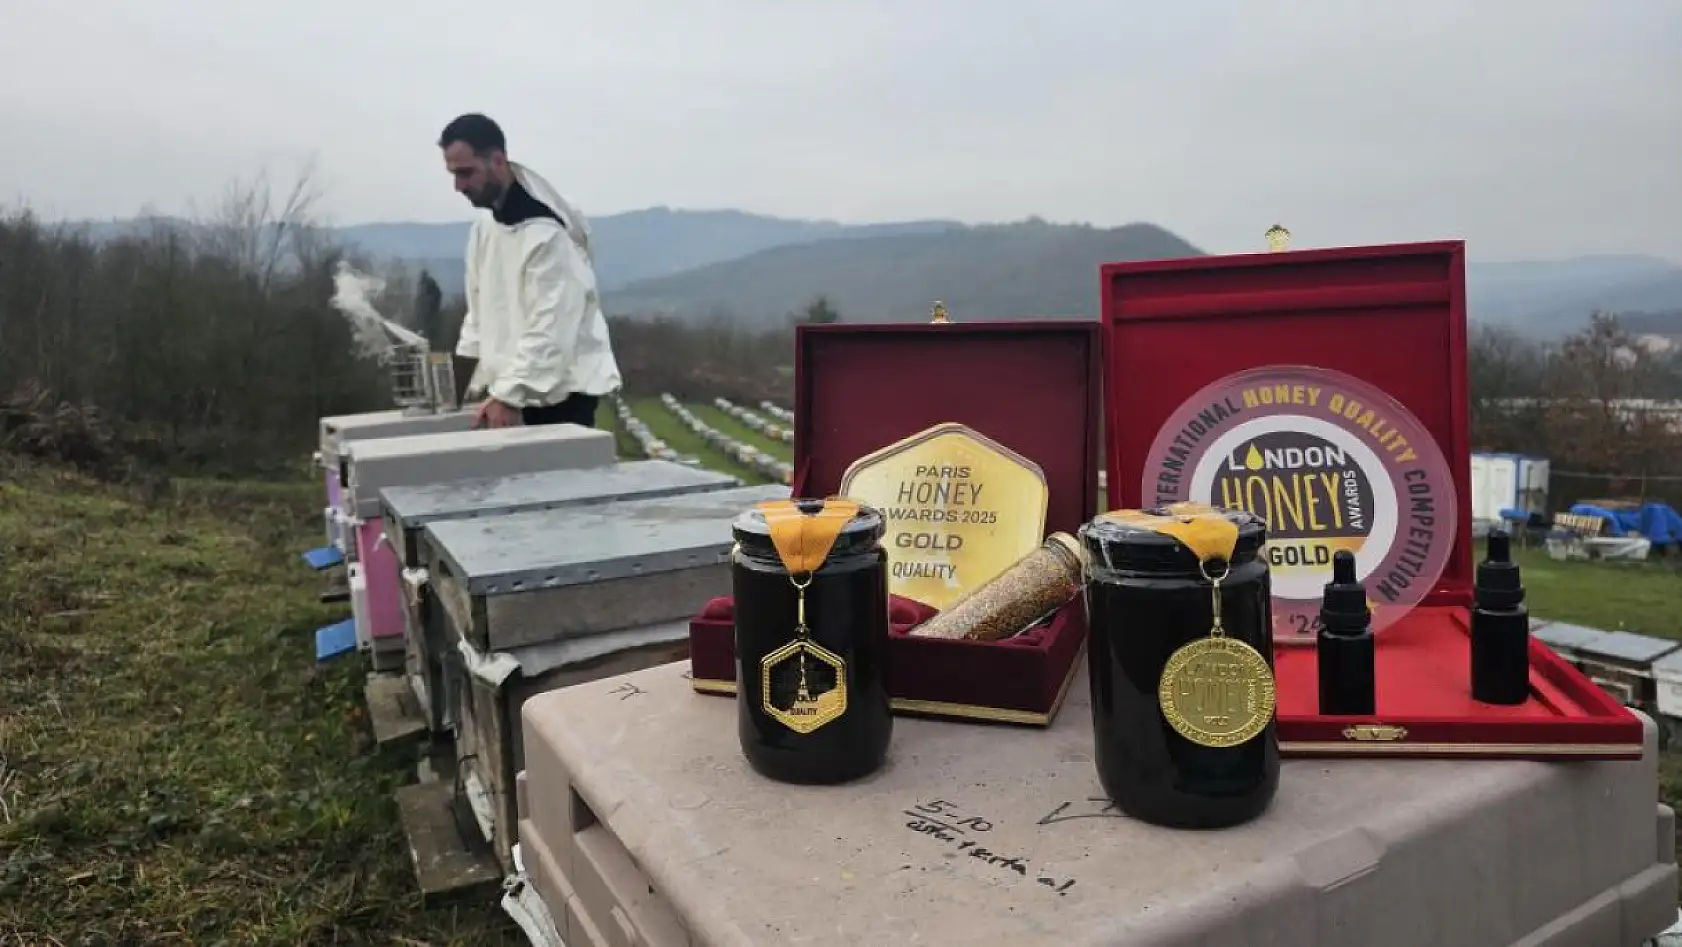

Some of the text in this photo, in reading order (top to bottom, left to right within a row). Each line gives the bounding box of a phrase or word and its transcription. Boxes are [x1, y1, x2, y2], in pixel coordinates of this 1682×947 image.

[1227, 443, 1346, 471] LONDON
[916, 465, 972, 479] PARIS
[898, 481, 984, 506] HONEY
[1221, 472, 1344, 533] HONEY
[1242, 384, 1321, 410] HONEY
[1328, 394, 1418, 464] QUALITY
[1375, 468, 1434, 602] COMPETITION
[1343, 470, 1365, 530] AWARDS
[961, 510, 998, 524] 2025
[895, 532, 964, 550] GOLD
[1269, 545, 1329, 566] GOLD
[892, 561, 957, 579] QUALITY
